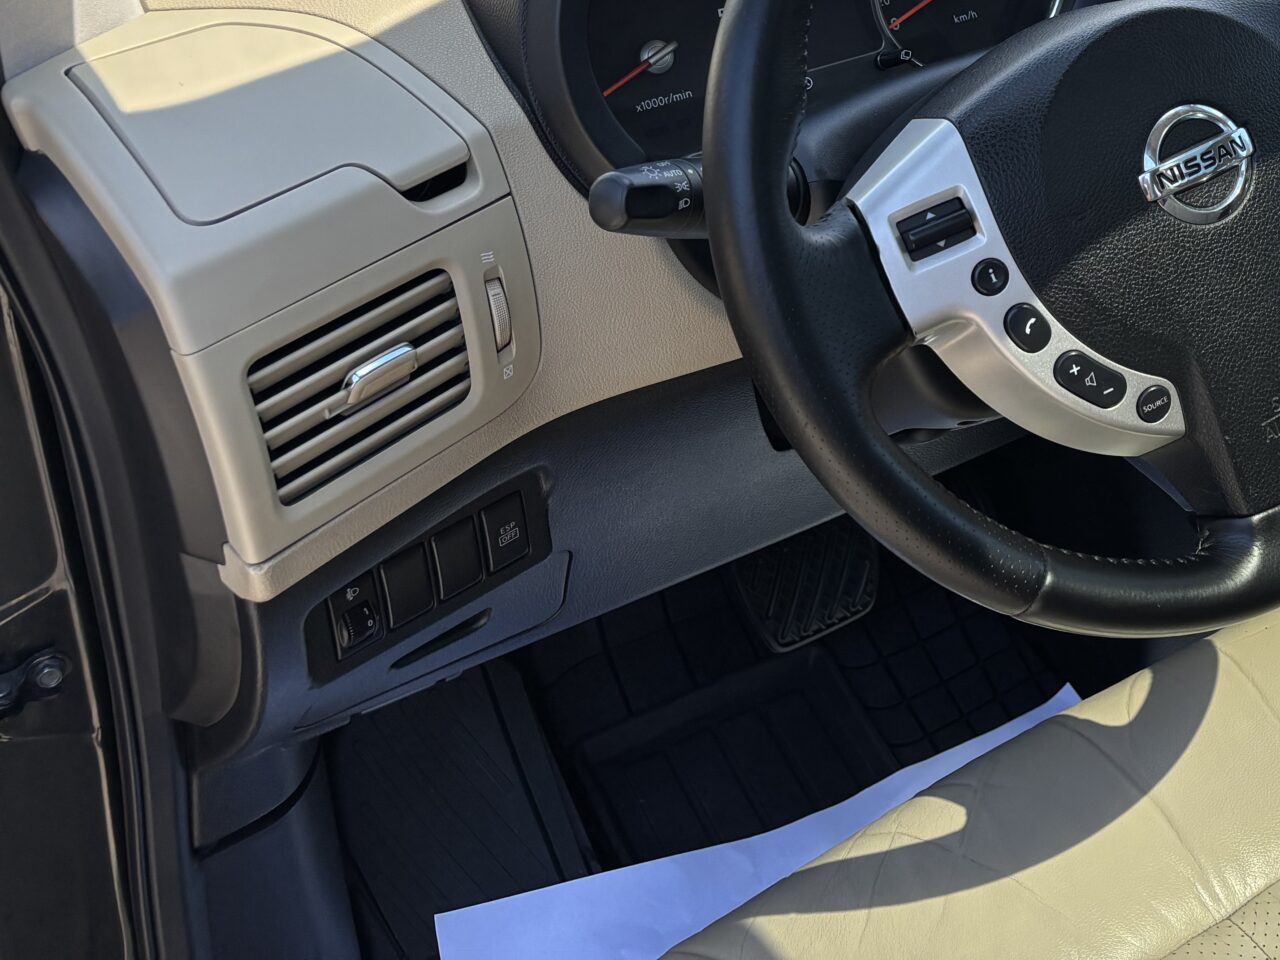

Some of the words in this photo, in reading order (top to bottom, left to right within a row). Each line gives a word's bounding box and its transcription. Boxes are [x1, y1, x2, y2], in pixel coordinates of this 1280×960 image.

[954, 11, 978, 24] km/h
[635, 90, 693, 113] x1000r/min
[1156, 135, 1248, 190] NISSAN
[663, 169, 682, 178] AUTO
[1143, 396, 1169, 414] SOURCE
[500, 521, 516, 534] ESP
[502, 530, 517, 543] OFF
